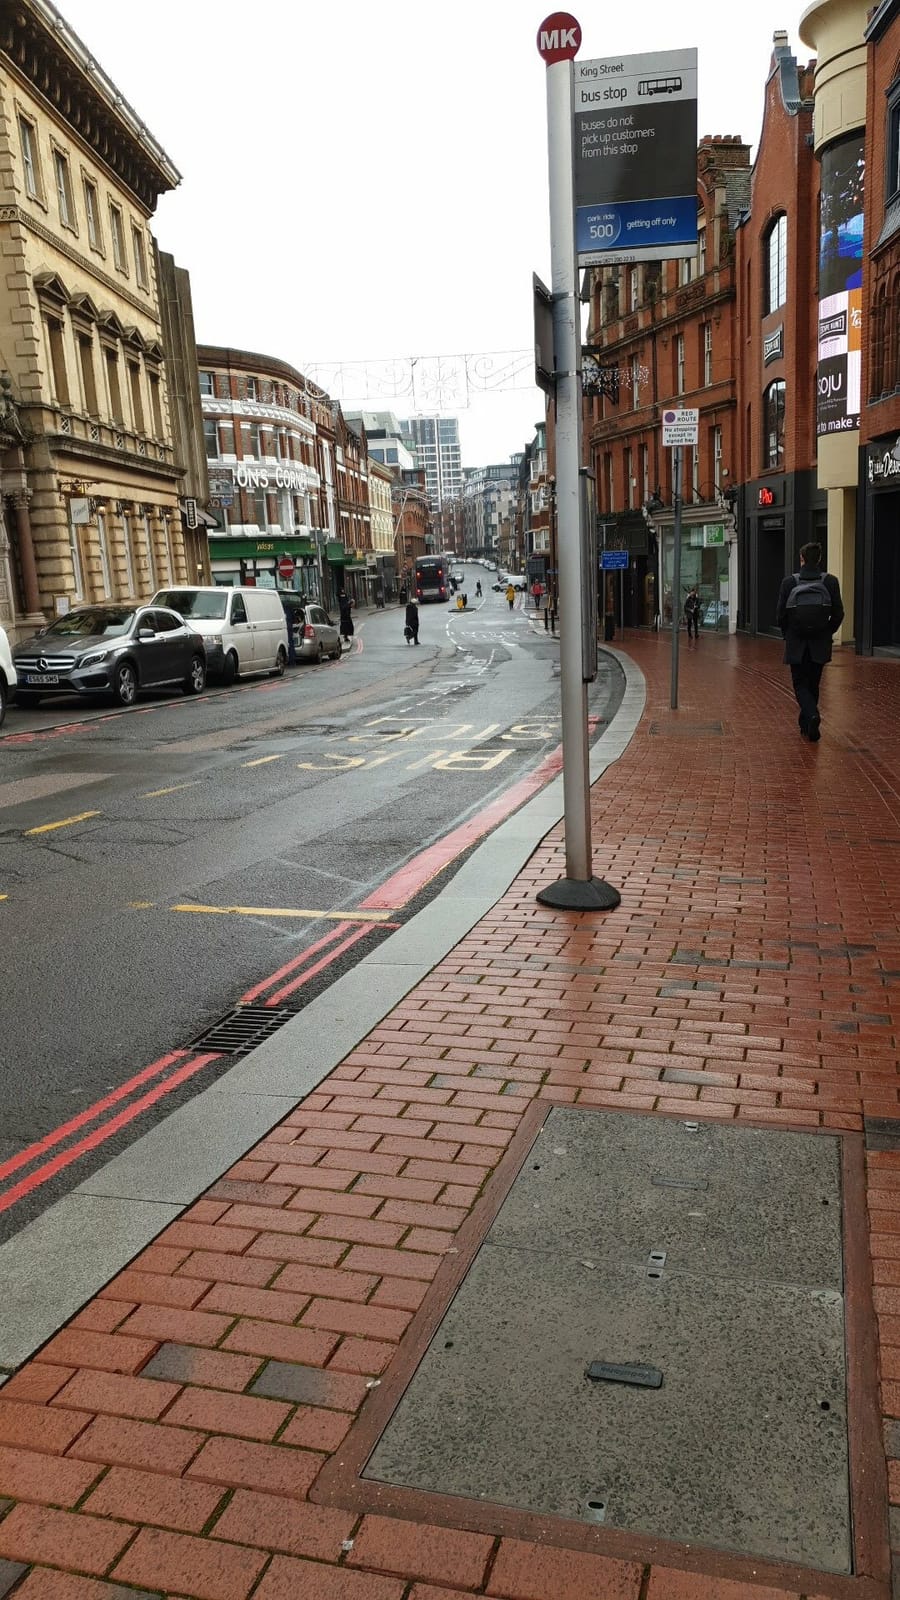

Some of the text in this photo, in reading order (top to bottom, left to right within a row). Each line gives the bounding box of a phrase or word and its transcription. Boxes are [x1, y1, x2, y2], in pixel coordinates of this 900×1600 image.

[540, 27, 577, 50] MK
[581, 62, 624, 77] King Street
[581, 86, 627, 103] bus stop
[581, 114, 634, 131] buses do not
[582, 128, 655, 146] pick up customers
[582, 143, 638, 158] from this stop
[590, 223, 613, 239] 500
[626, 216, 677, 230] getting off only
[828, 416, 853, 430] make
